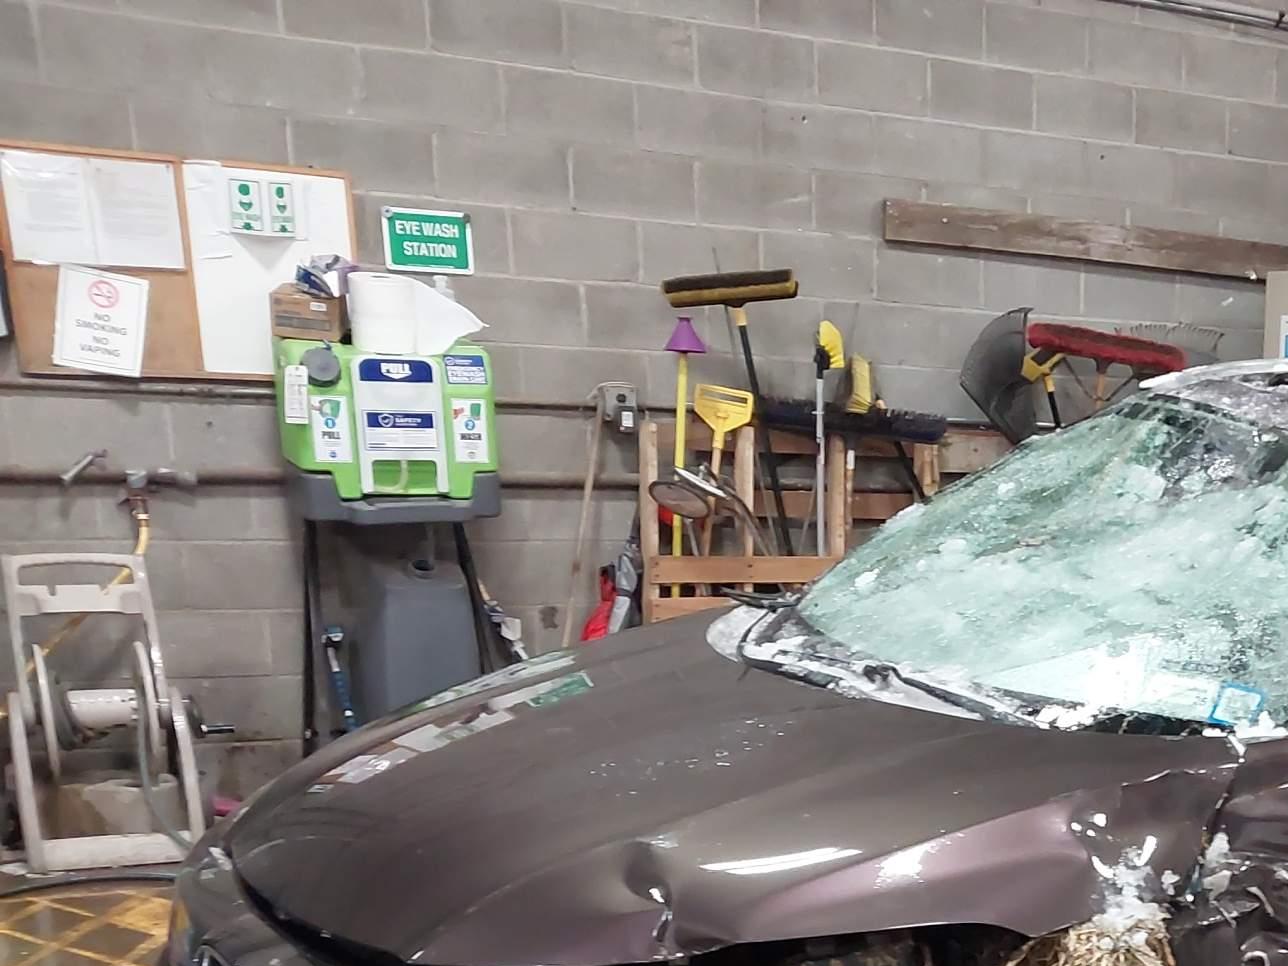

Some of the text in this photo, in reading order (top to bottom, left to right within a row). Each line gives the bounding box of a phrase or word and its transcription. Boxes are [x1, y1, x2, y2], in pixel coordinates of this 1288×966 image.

[395, 220, 459, 239] EYE WASH
[403, 241, 457, 258] STATION
[94, 313, 110, 322] NO
[75, 319, 127, 335] SMOKING
[92, 336, 109, 346] NO
[80, 344, 120, 357] VAPING
